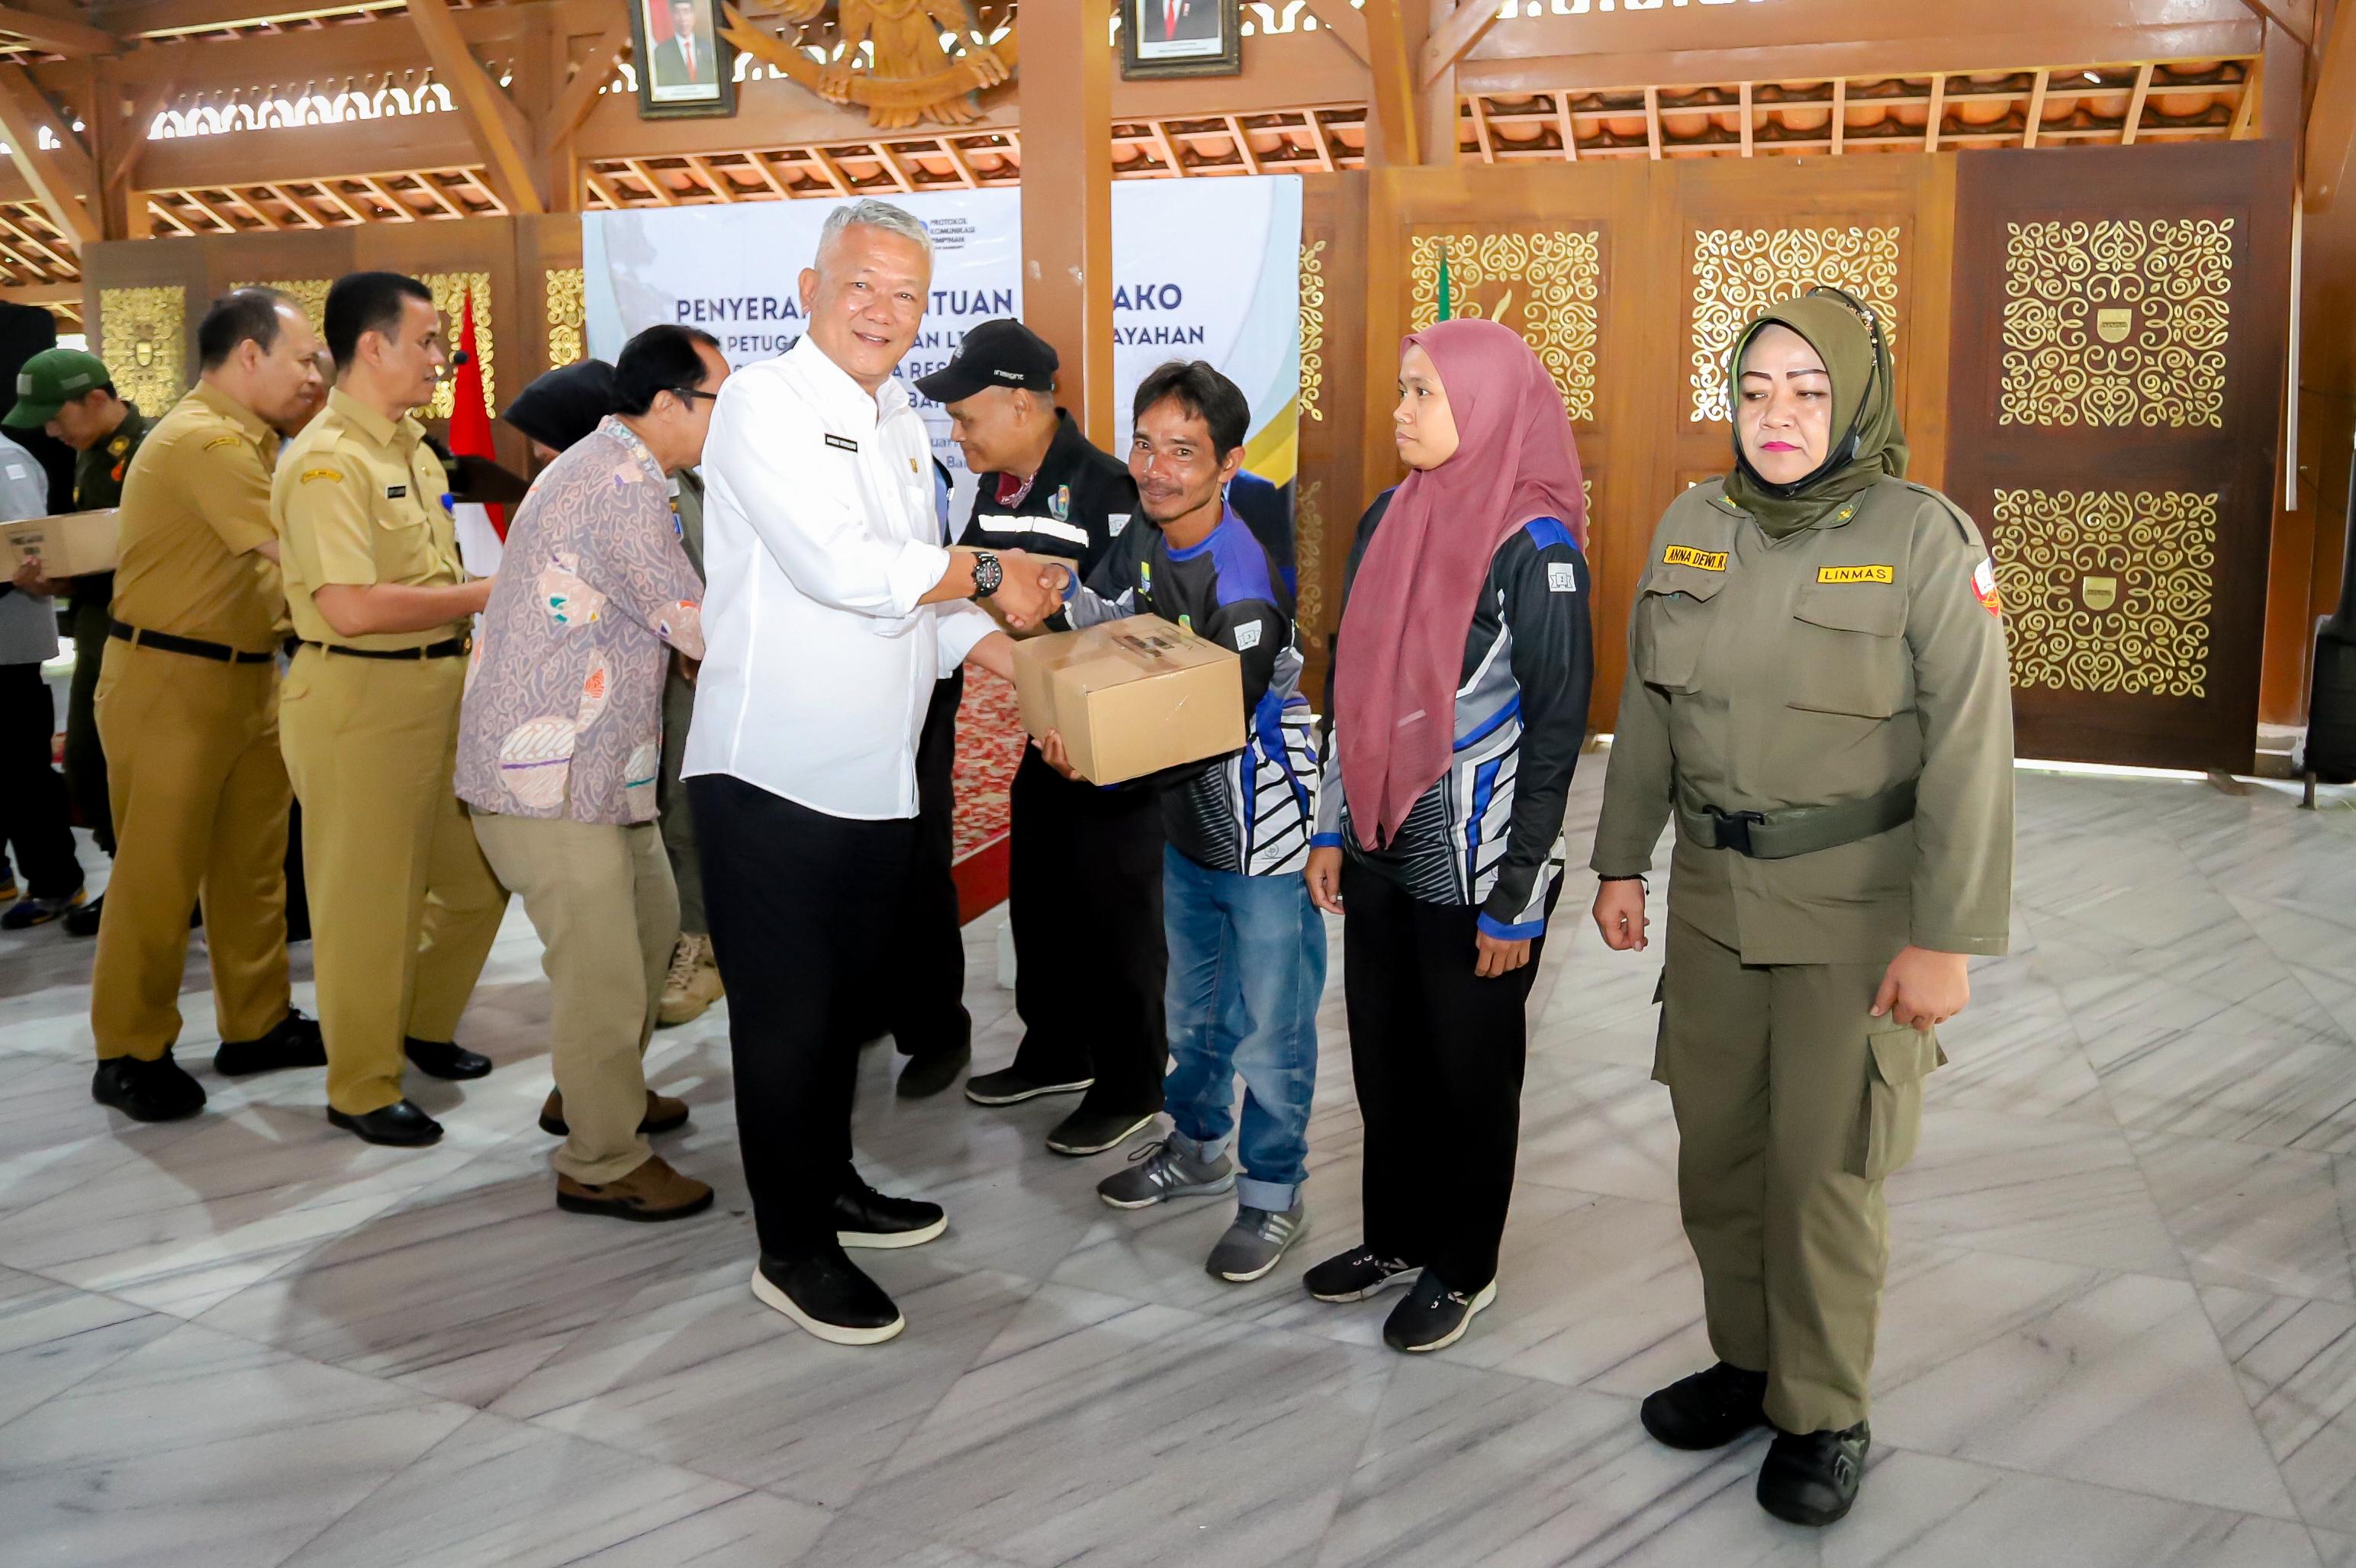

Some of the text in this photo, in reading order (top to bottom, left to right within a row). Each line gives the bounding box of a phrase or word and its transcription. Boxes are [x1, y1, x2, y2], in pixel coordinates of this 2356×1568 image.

[677, 295, 806, 322] PENYERA
[925, 289, 1012, 315] TUAN
[727, 334, 801, 352] PETUG
[1668, 549, 1691, 562] ANNA
[1824, 568, 1886, 580] LINMAS
